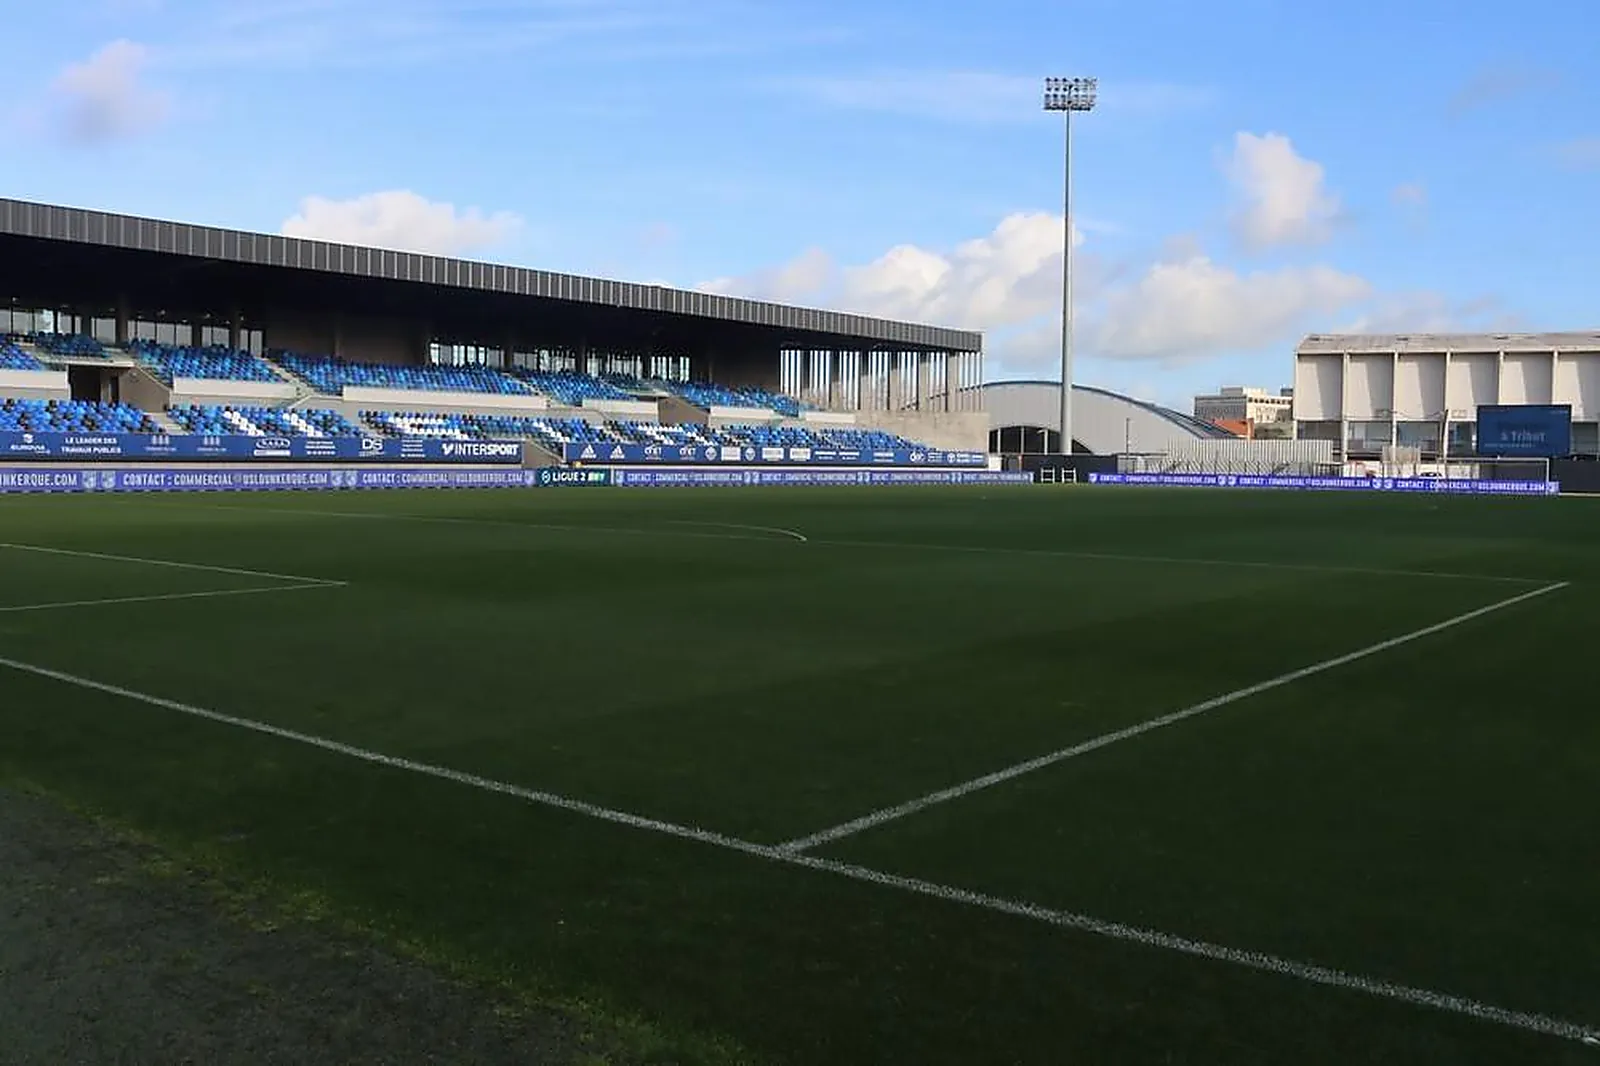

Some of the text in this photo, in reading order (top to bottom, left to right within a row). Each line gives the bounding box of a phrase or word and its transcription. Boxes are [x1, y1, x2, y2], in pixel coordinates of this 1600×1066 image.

[455, 443, 519, 455] INTERSPORT
[123, 473, 165, 486] CONTACT
[362, 473, 396, 484] CONTACT
[552, 471, 578, 481] LIGUE
[580, 471, 586, 481] 2
[1397, 480, 1424, 489] CONTACT
